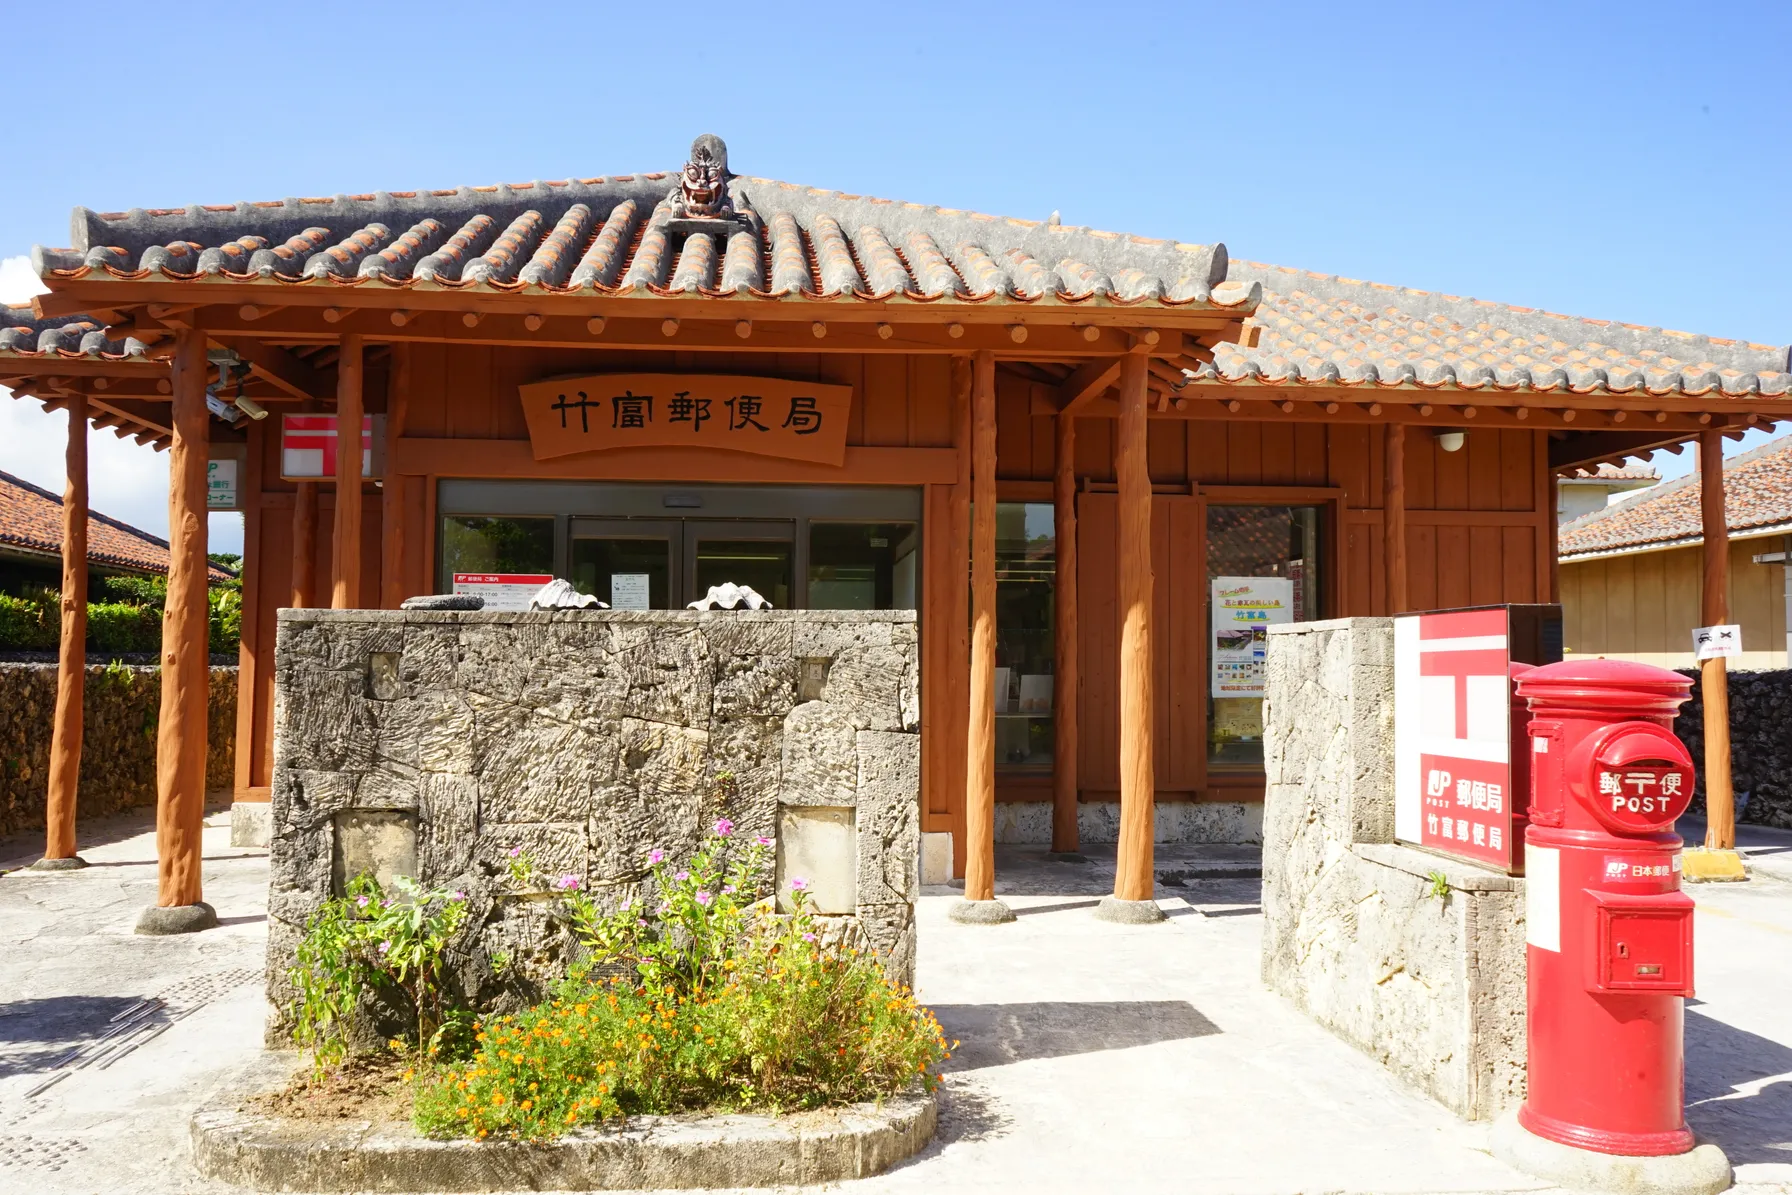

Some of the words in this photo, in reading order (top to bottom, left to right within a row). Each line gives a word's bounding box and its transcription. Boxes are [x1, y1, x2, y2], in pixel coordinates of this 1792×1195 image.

[1236, 610, 1267, 620] 竹富島
[1426, 797, 1450, 808] POST
[1456, 779, 1502, 813] 郵便局
[1612, 797, 1670, 812] POST
[1427, 813, 1502, 850] 竹富郵便局
[1632, 866, 1670, 876] 日本郵便
